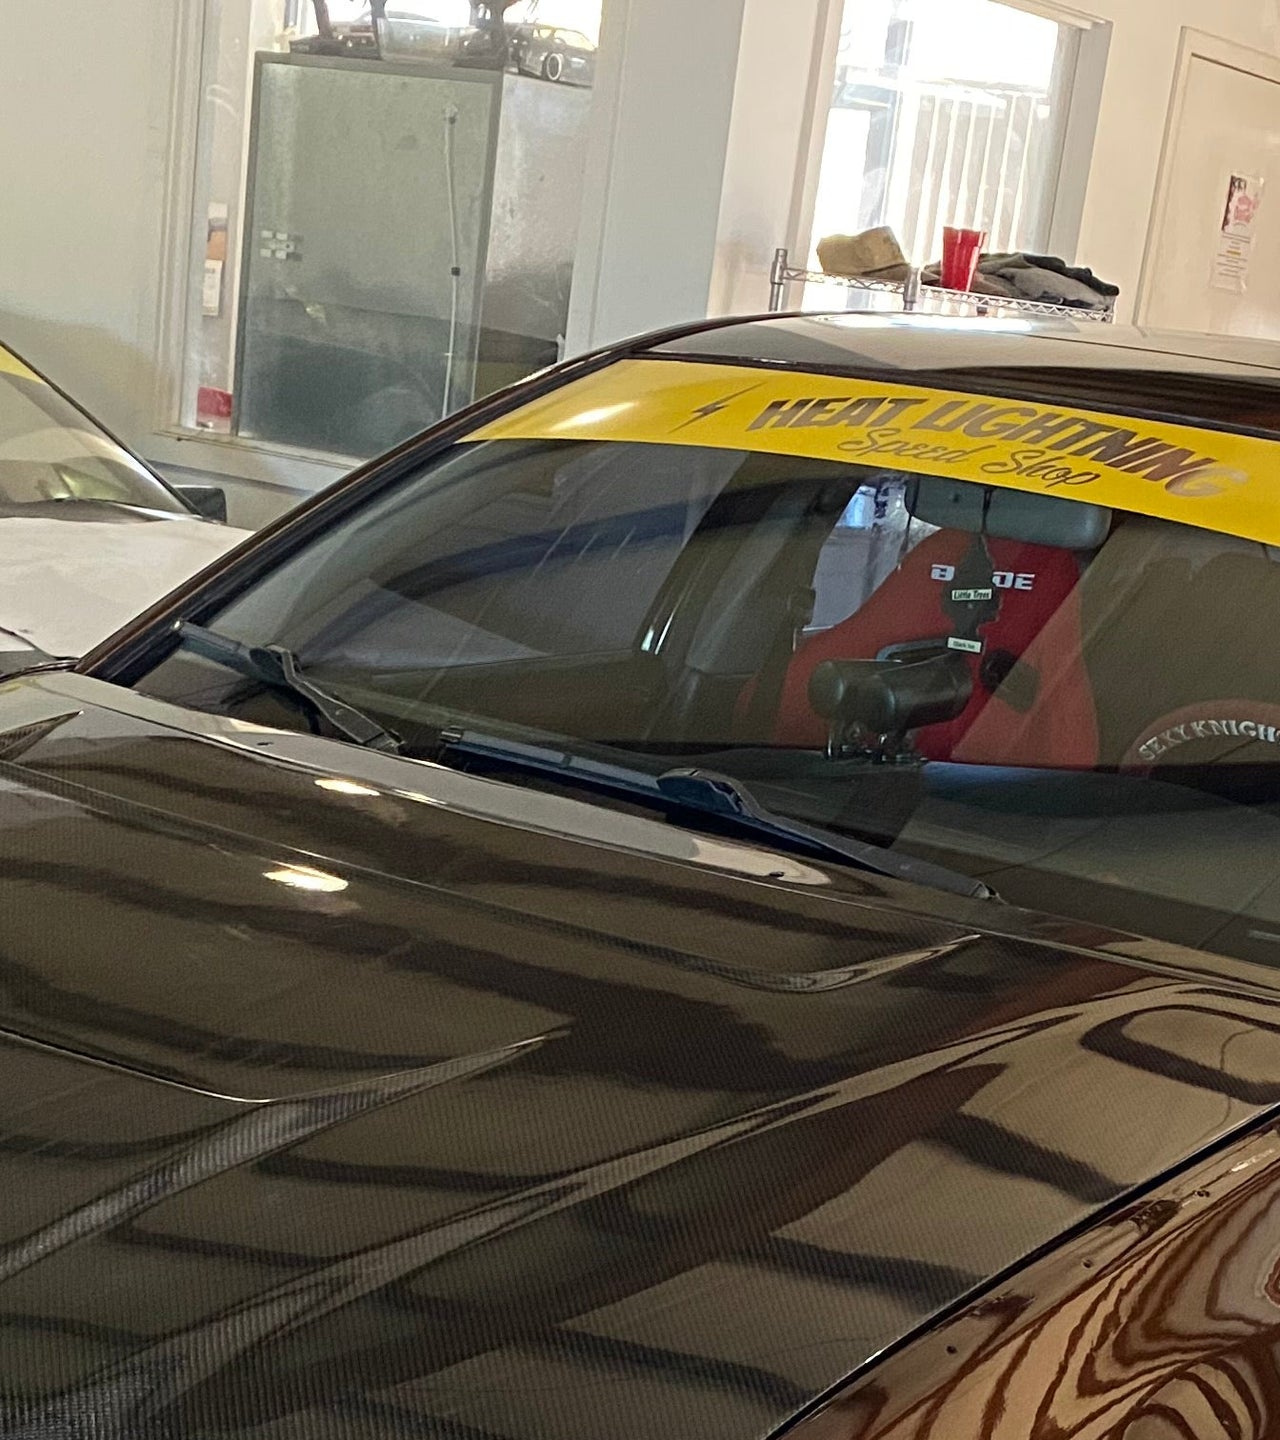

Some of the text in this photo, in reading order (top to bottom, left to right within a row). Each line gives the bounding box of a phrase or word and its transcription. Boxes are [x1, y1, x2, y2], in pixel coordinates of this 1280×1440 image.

[744, 396, 1250, 498] HEAT LIGHTNING
[836, 427, 1102, 488] Speed Shop
[930, 563, 1036, 591] BDE
